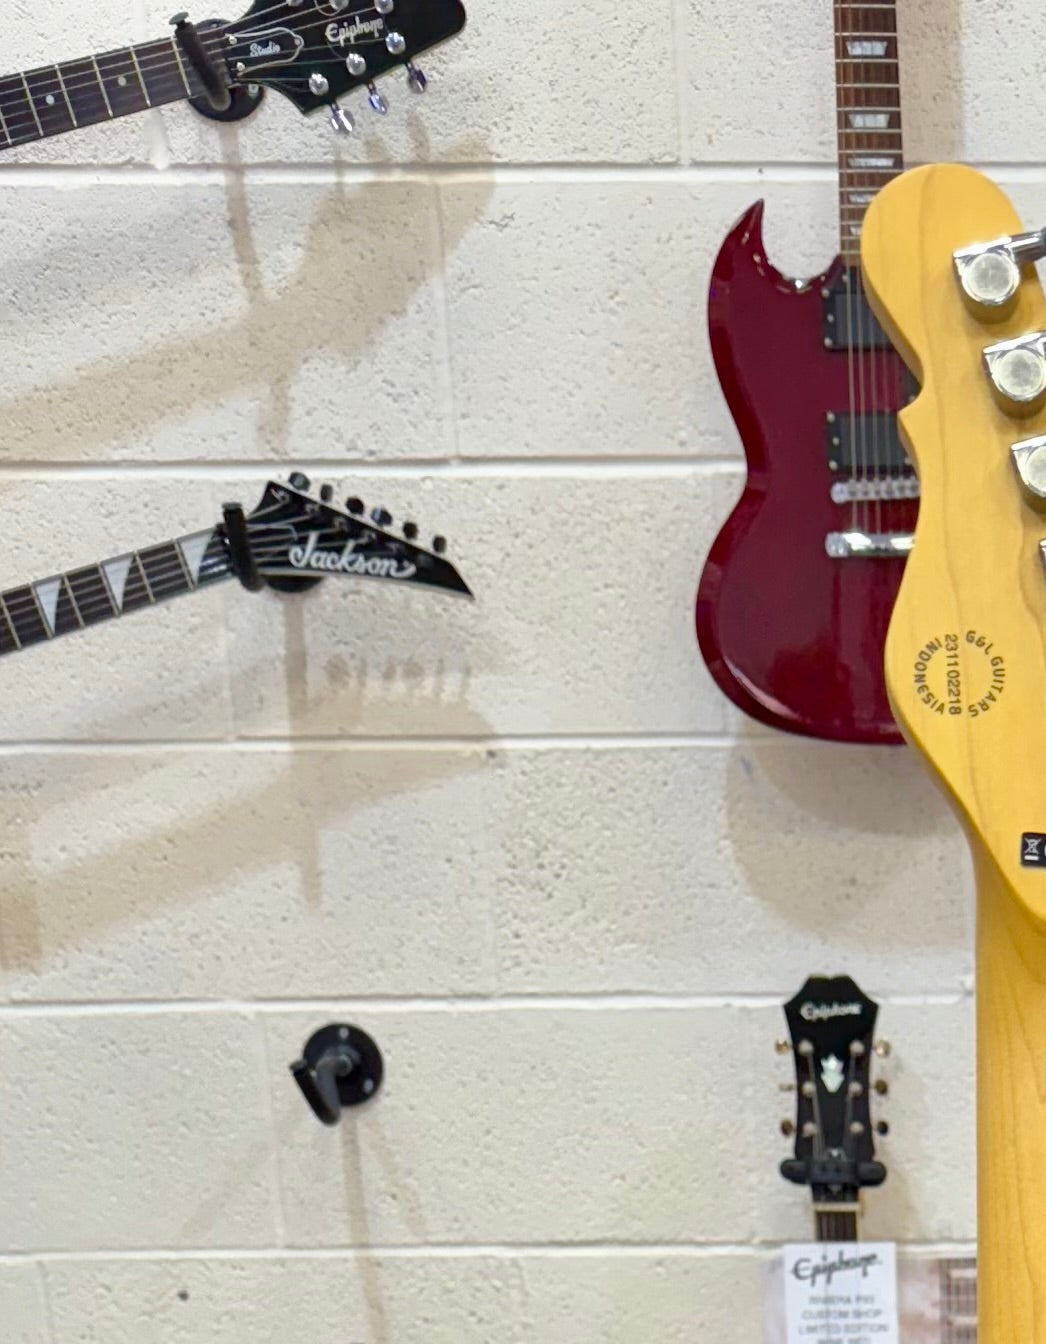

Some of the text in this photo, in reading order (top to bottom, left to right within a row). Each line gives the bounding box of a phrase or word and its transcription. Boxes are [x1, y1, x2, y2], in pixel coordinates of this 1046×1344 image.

[250, 41, 281, 57] Studio
[325, 16, 384, 46] Epiphone
[288, 531, 418, 578] Jackson
[914, 637, 945, 716] INDONESIA
[944, 633, 963, 716] 231102218
[967, 656, 1006, 717] GUITARS
[792, 1250, 878, 1287] Epiphone
